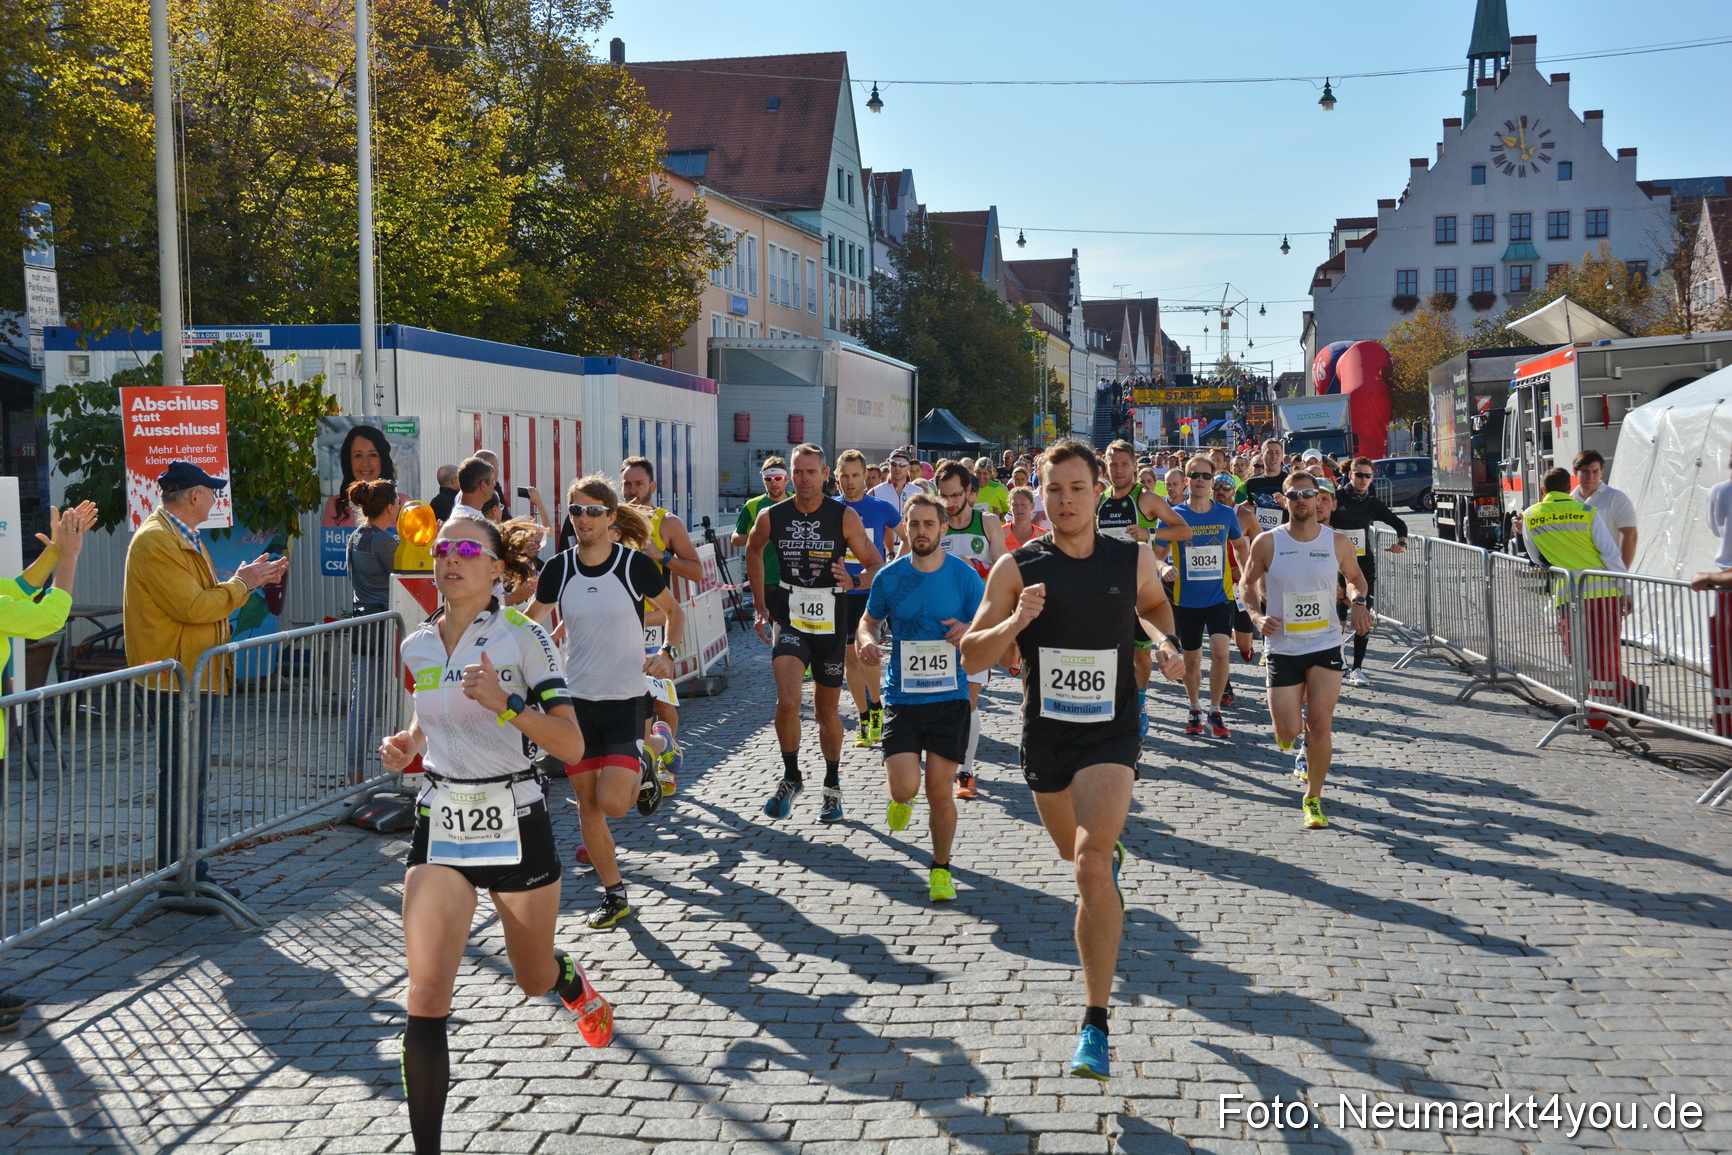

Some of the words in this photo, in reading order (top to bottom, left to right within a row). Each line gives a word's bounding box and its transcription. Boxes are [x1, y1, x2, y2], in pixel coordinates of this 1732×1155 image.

[42, 275, 51, 283] mit
[28, 282, 56, 294] Parkschein
[32, 294, 54, 306] werktags
[30, 306, 44, 314] Mo-Fr
[1166, 392, 1200, 400] START
[132, 396, 219, 411] Abschluss
[132, 413, 160, 422] statt
[133, 422, 220, 437] Ausschluss!
[149, 446, 173, 454] Mehr
[175, 445, 204, 454] Lehrer
[206, 444, 218, 453] für
[184, 455, 219, 464] Klassen.
[1258, 515, 1278, 525] 2639
[1530, 513, 1584, 525] Org.-Leiter
[779, 540, 834, 550] PIRATE
[326, 560, 347, 570] CSU
[1192, 555, 1217, 566] 3034
[799, 602, 823, 616] 148
[1295, 603, 1320, 617] 328
[645, 630, 656, 641] 79
[909, 655, 947, 671] 2145
[1051, 668, 1105, 692] 2486
[1054, 702, 1101, 714] Maximilian
[450, 792, 487, 802] BOCK
[441, 806, 503, 832] 3128
